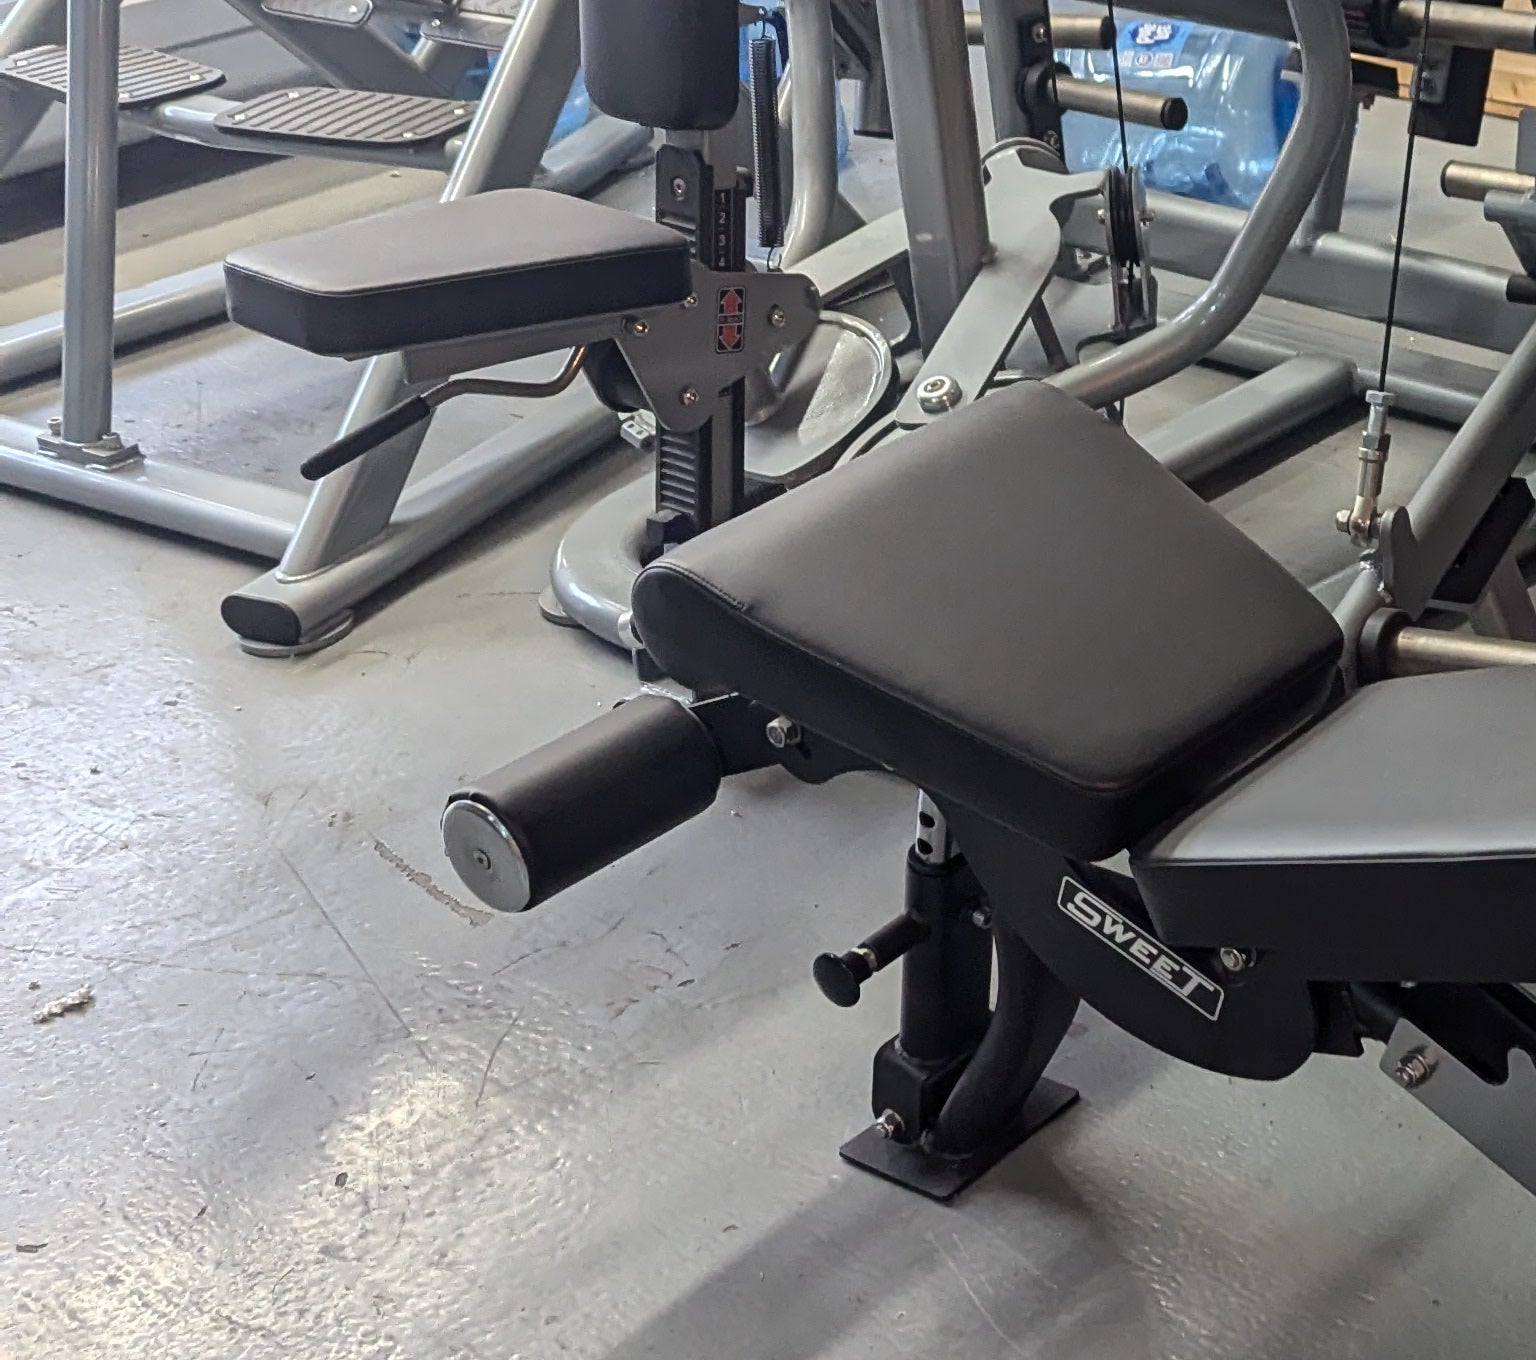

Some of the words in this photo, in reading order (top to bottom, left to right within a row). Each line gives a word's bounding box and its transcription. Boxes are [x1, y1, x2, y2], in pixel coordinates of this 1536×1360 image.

[719, 191, 726, 204] 1
[718, 211, 727, 225] 2
[718, 233, 727, 247] 3
[1066, 890, 1215, 998] SWEET
